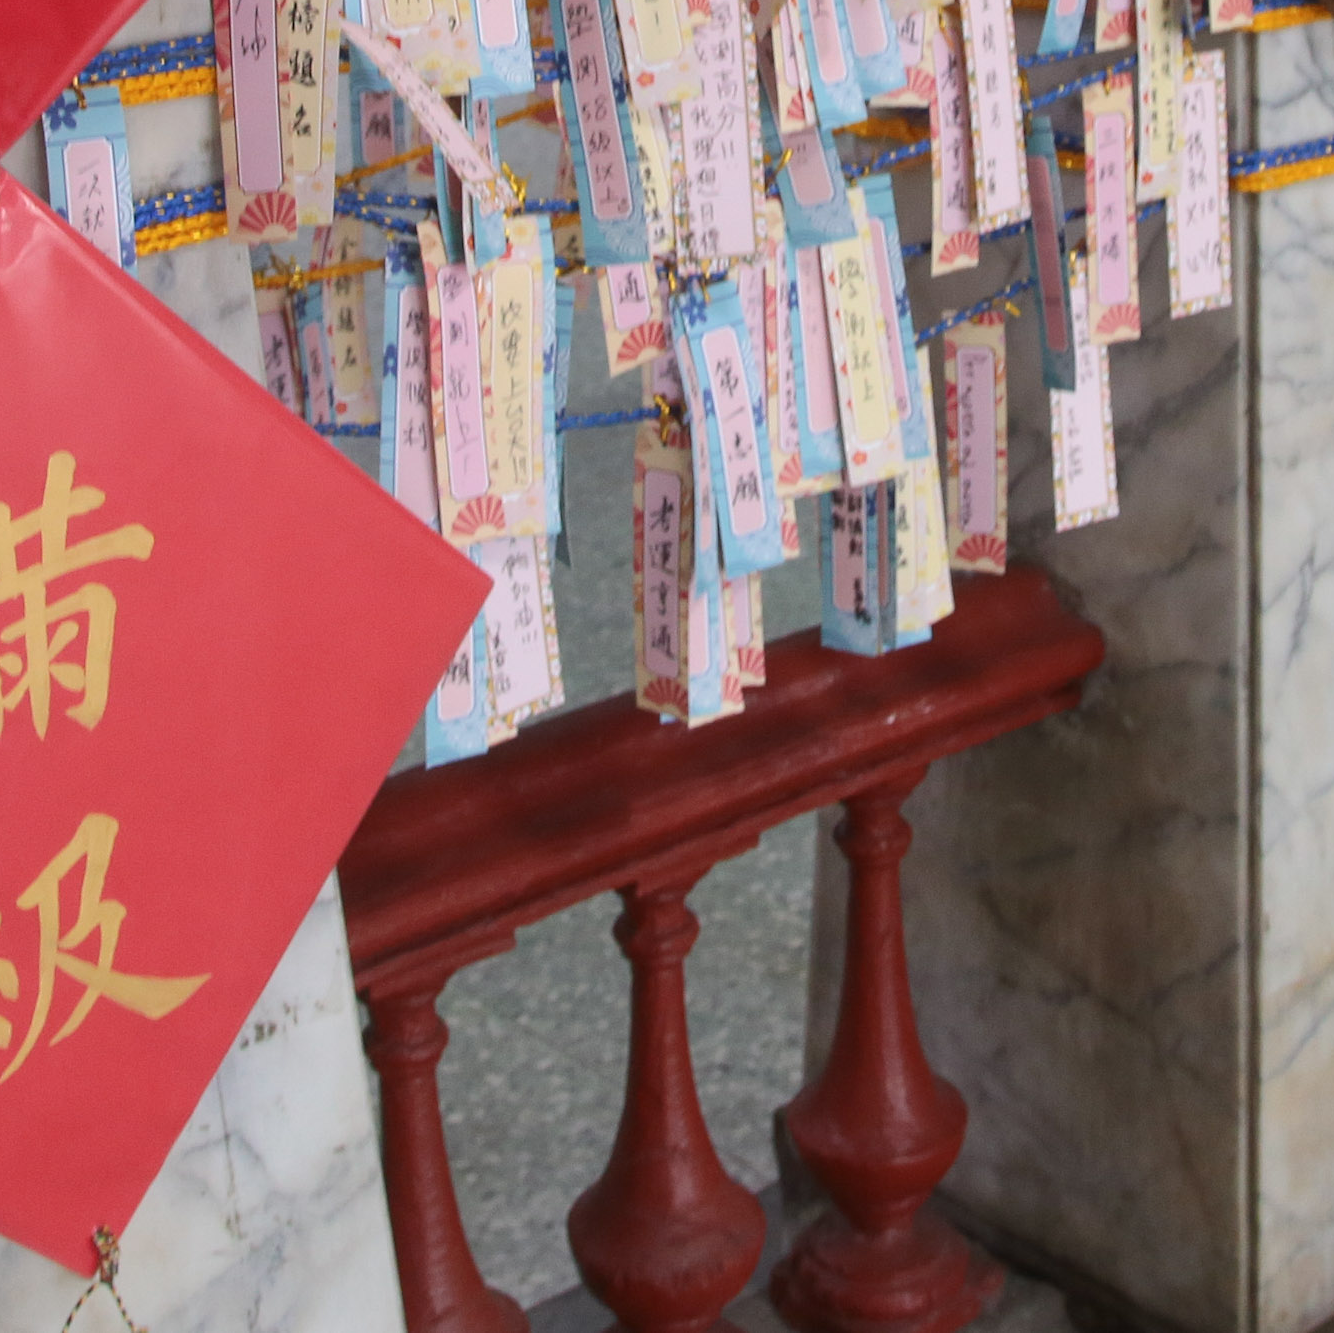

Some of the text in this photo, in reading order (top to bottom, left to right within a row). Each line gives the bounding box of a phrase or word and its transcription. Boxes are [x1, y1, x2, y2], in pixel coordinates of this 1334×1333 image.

[938, 53, 969, 213] 考運亨通
[717, 358, 761, 506] 第一志願
[648, 496, 675, 662] 考運亨通
